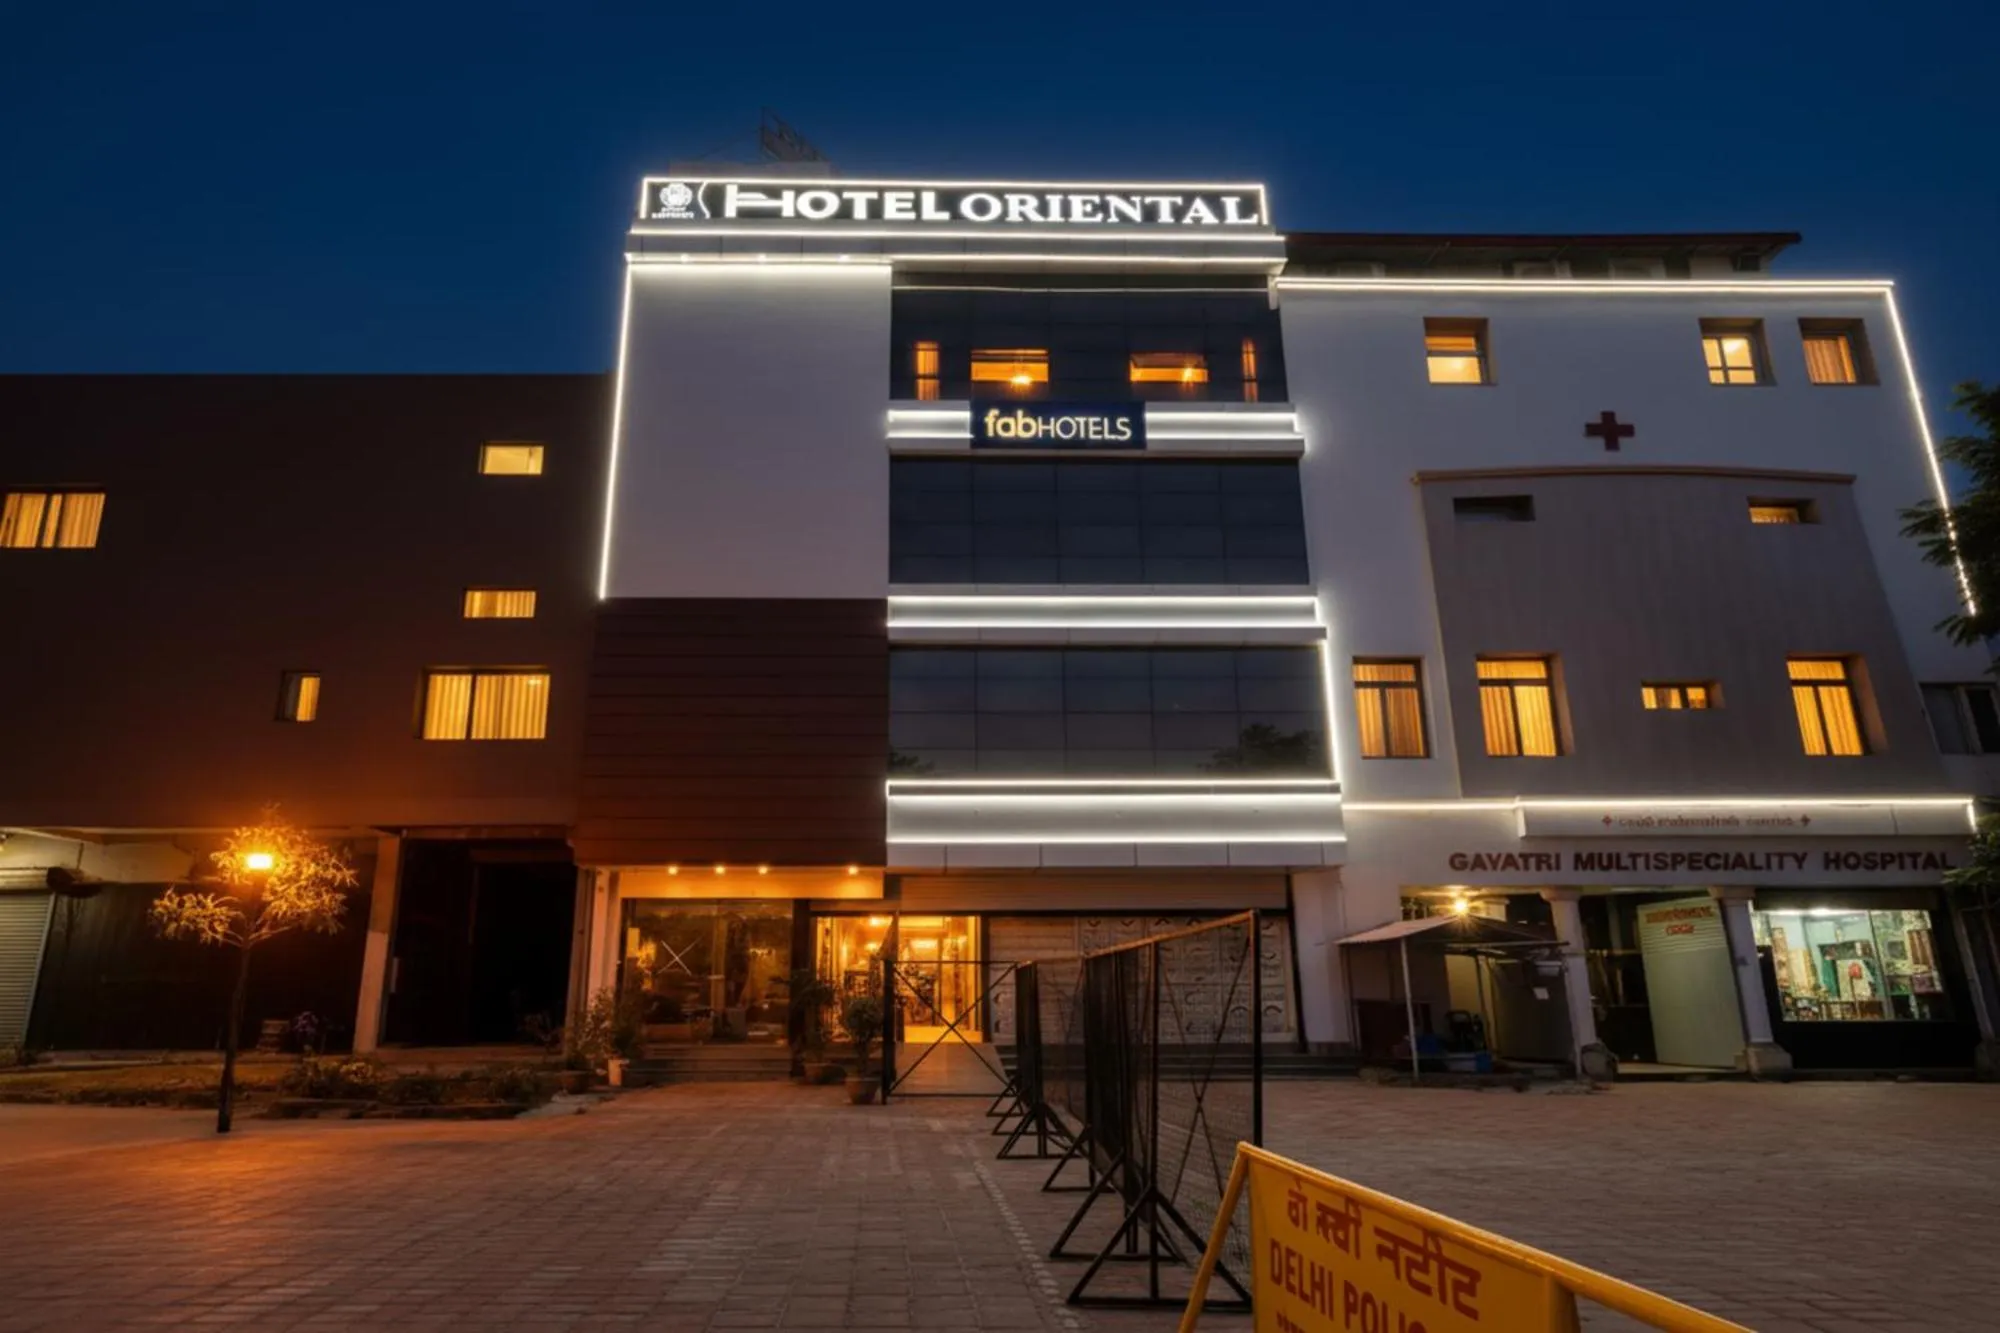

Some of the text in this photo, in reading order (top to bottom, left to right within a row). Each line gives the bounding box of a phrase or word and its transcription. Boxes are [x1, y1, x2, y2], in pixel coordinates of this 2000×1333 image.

[725, 184, 1258, 224] HOTEL ORIENTAL
[985, 409, 1132, 440] fabHOTELS
[1448, 852, 1956, 872] GAYATRI MULTISPECIALITY HOSPITAL
[1270, 1238, 1333, 1322] DELHI
